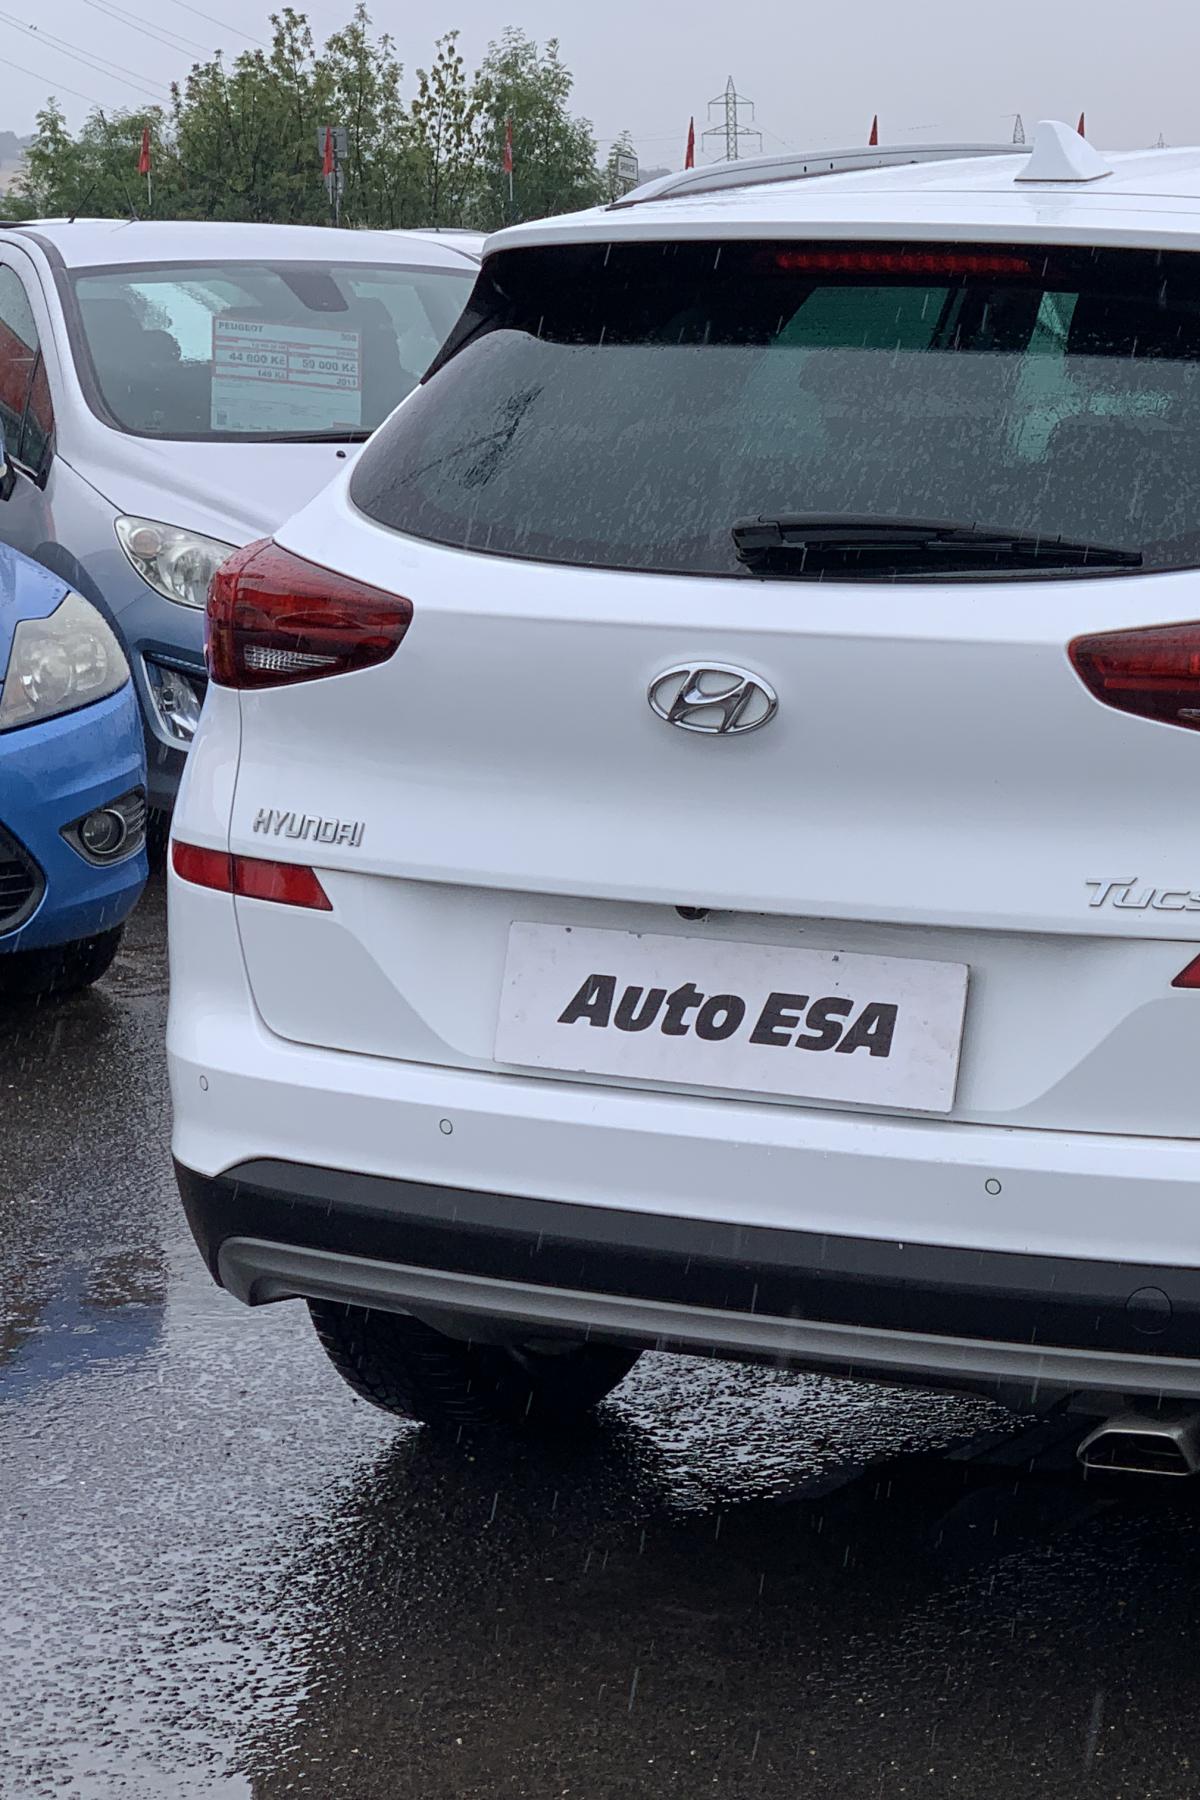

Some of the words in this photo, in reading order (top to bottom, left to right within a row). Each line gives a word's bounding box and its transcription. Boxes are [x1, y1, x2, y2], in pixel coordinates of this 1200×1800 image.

[218, 321, 264, 333] PEUGEOT
[253, 808, 366, 848] HYUNDAI
[557, 973, 746, 1042] Auto
[749, 992, 899, 1058] ESA
